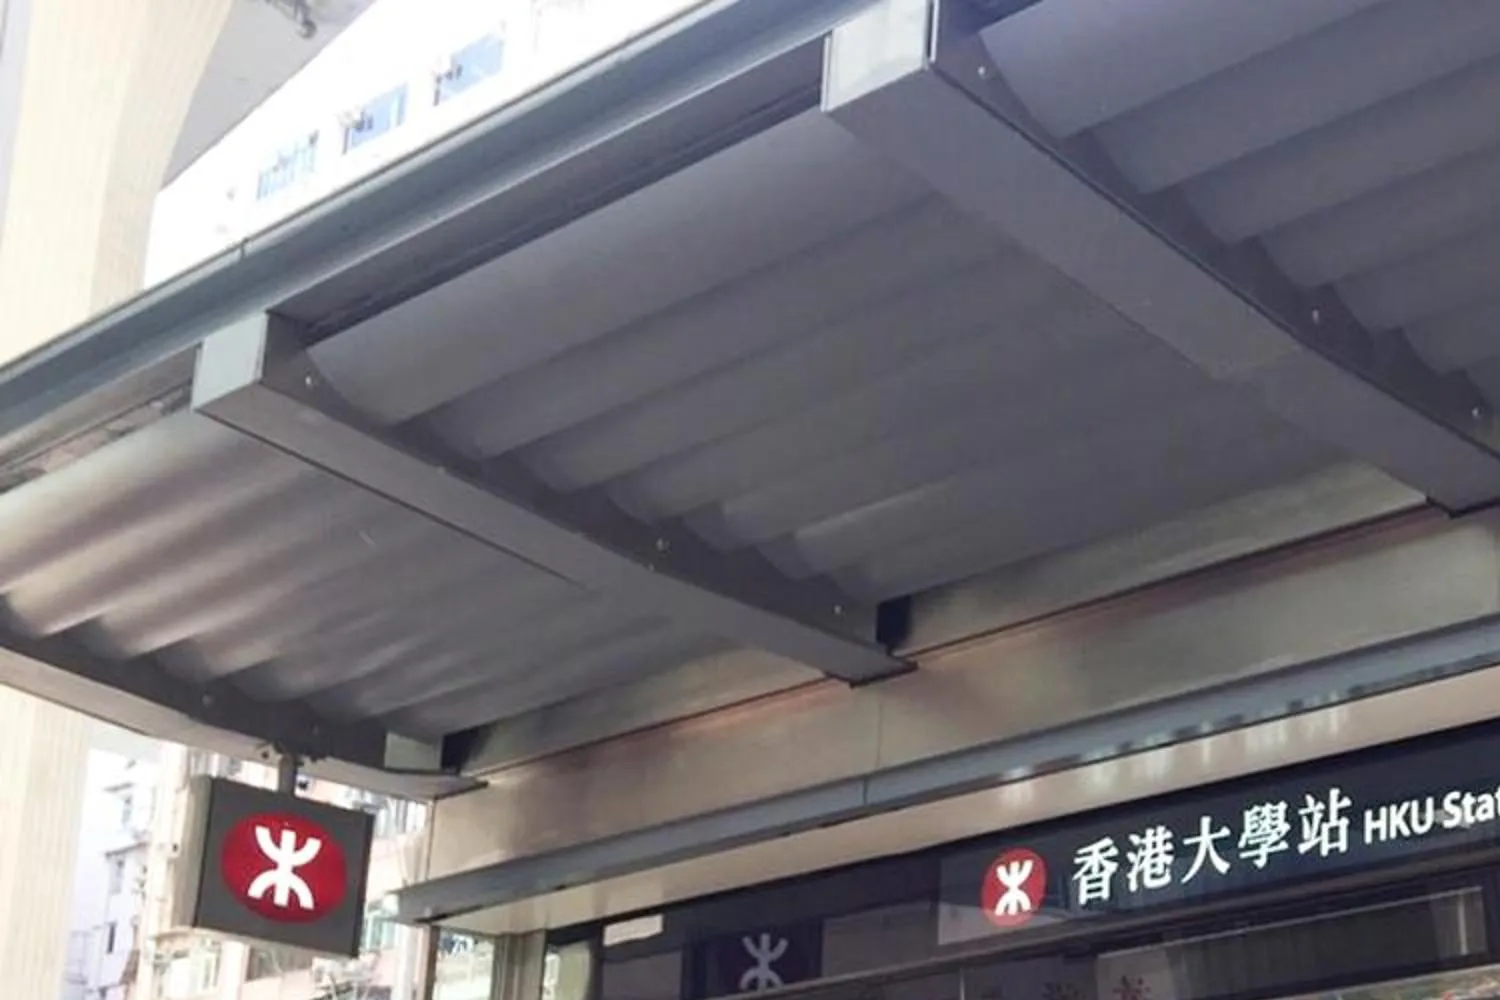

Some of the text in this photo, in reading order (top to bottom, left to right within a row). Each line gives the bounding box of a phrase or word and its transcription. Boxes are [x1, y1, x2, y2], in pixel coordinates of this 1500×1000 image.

[1072, 787, 1352, 905] 香港大學站
[1363, 796, 1435, 845] HKU
